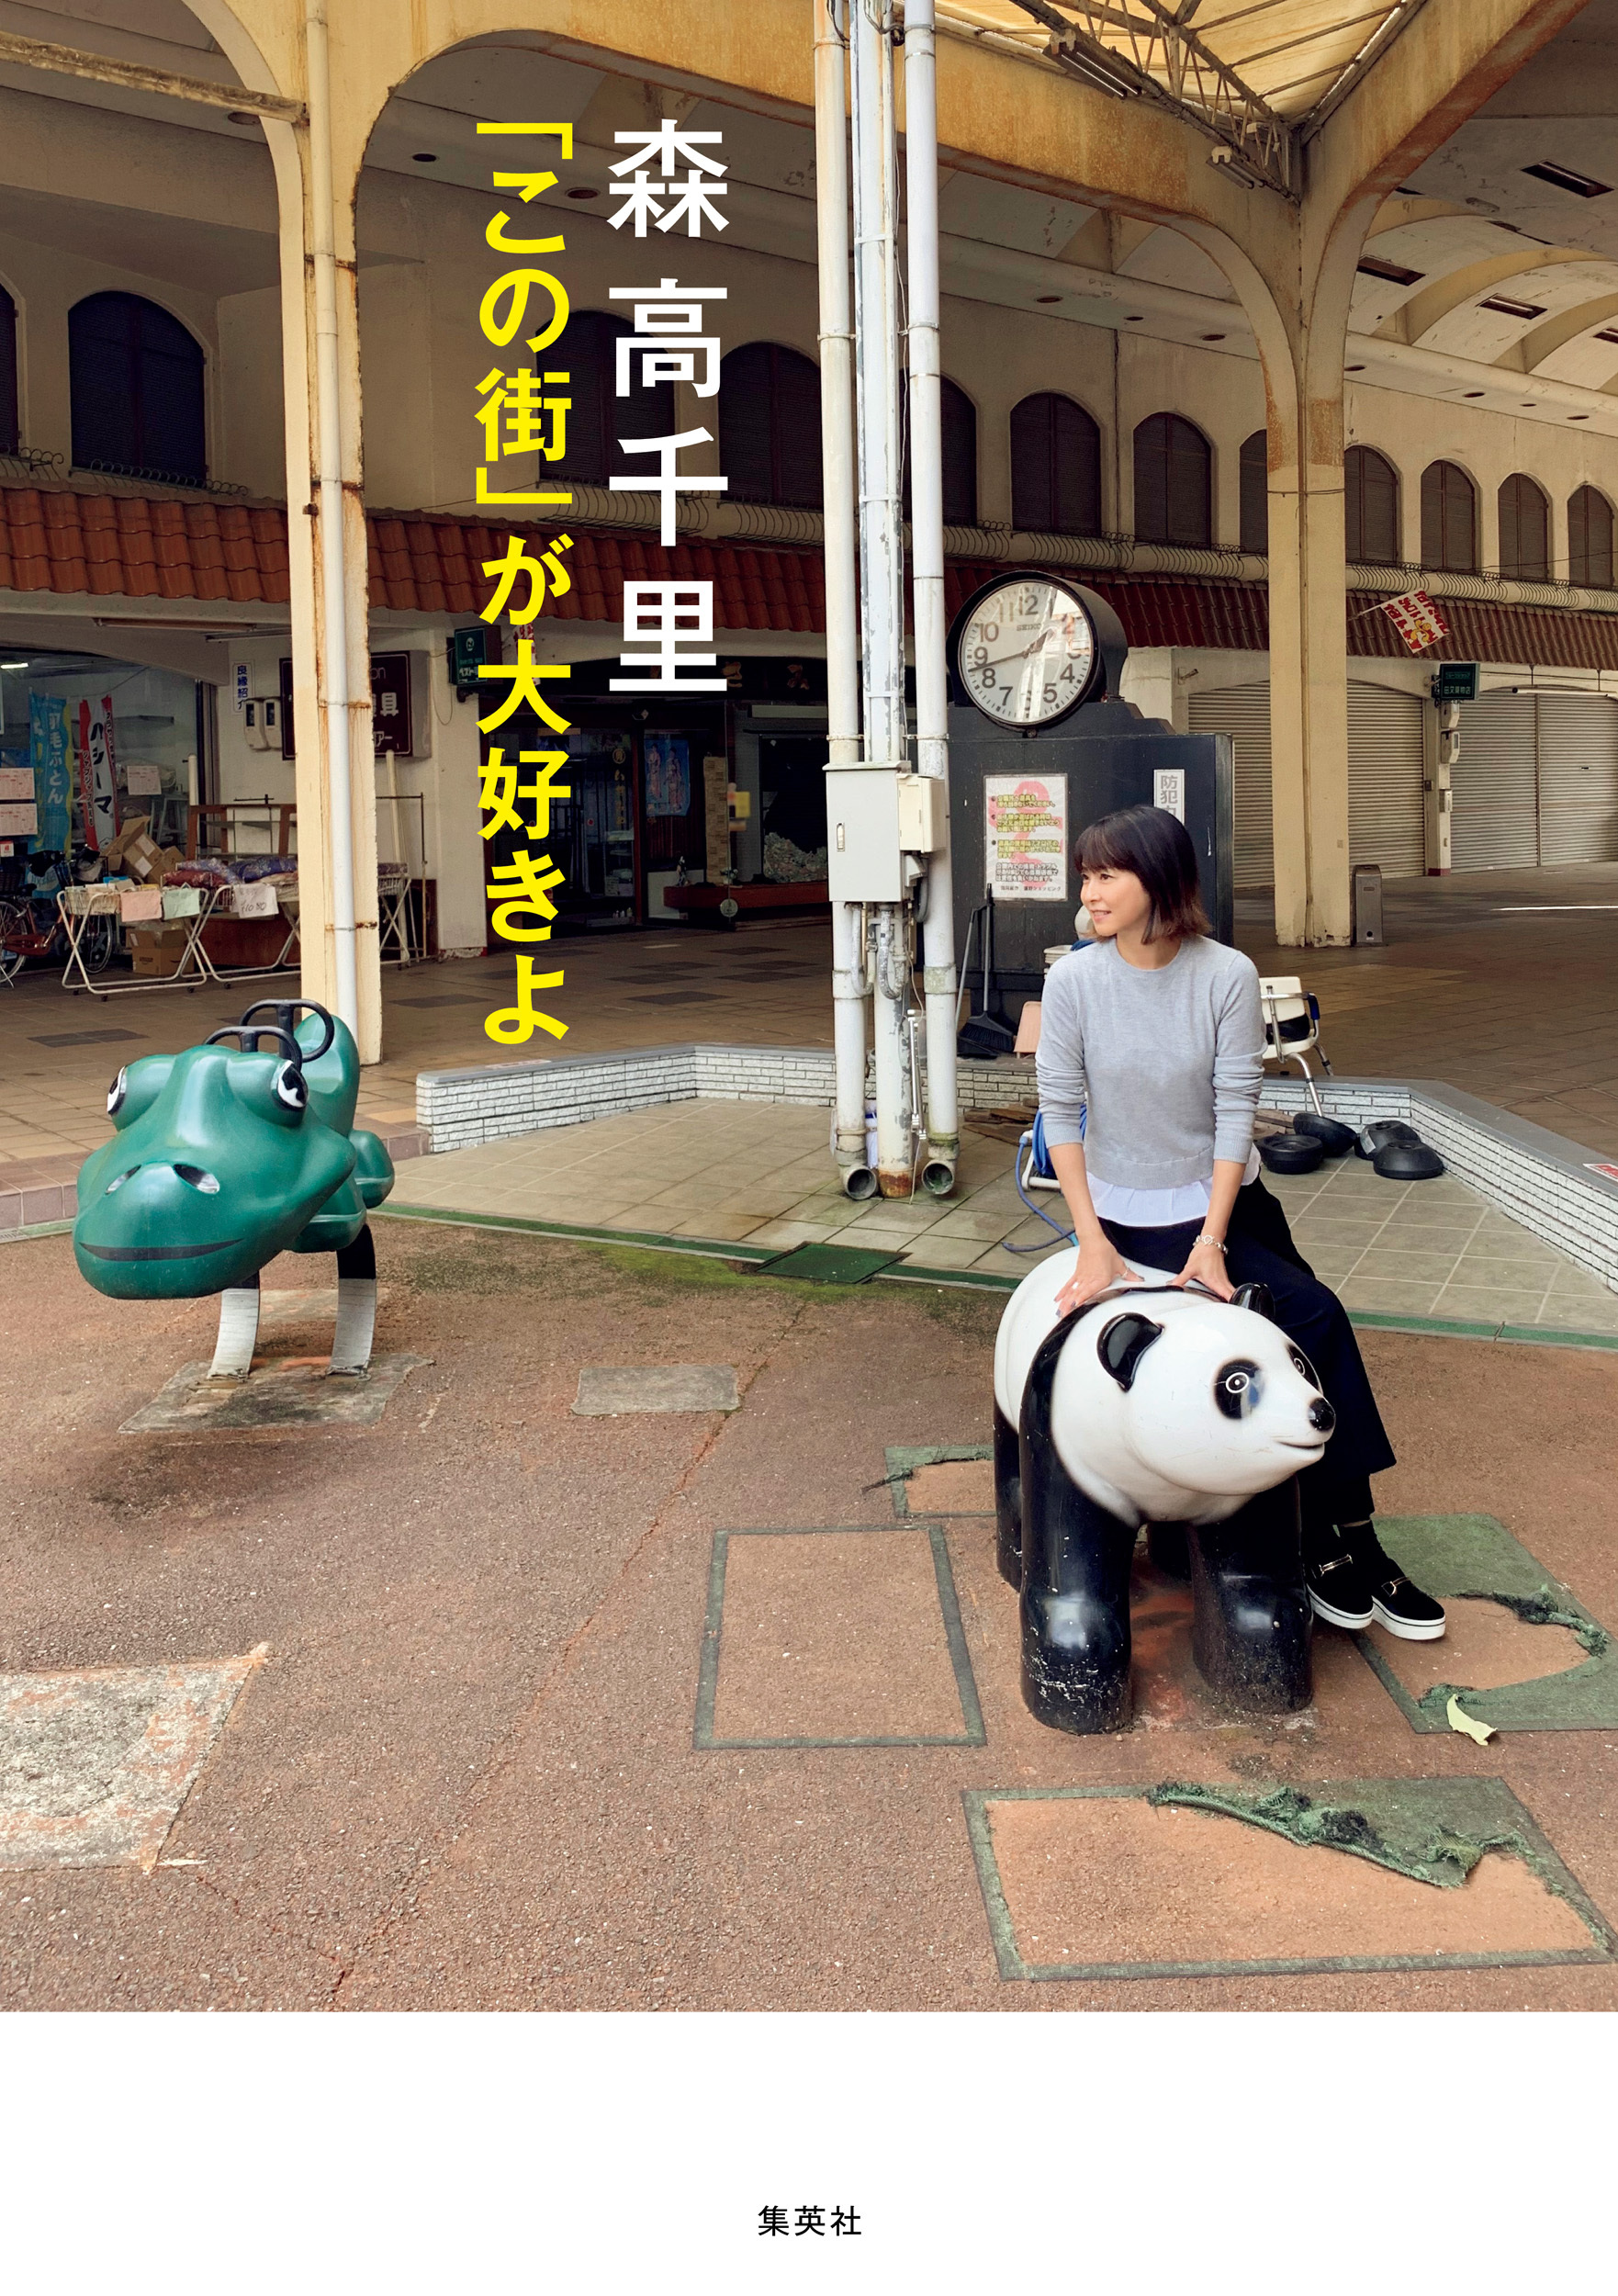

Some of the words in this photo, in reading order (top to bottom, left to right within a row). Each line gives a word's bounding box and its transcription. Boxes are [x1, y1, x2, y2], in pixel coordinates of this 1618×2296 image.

[998, 602, 1015, 623] 11
[1018, 594, 1039, 615] 12
[979, 622, 999, 642] 10
[974, 647, 988, 666] 9
[982, 668, 996, 689] 8
[1060, 663, 1075, 683] 4
[999, 686, 1013, 706] 7
[1043, 682, 1058, 703] 5
[372, 692, 399, 717] 具
